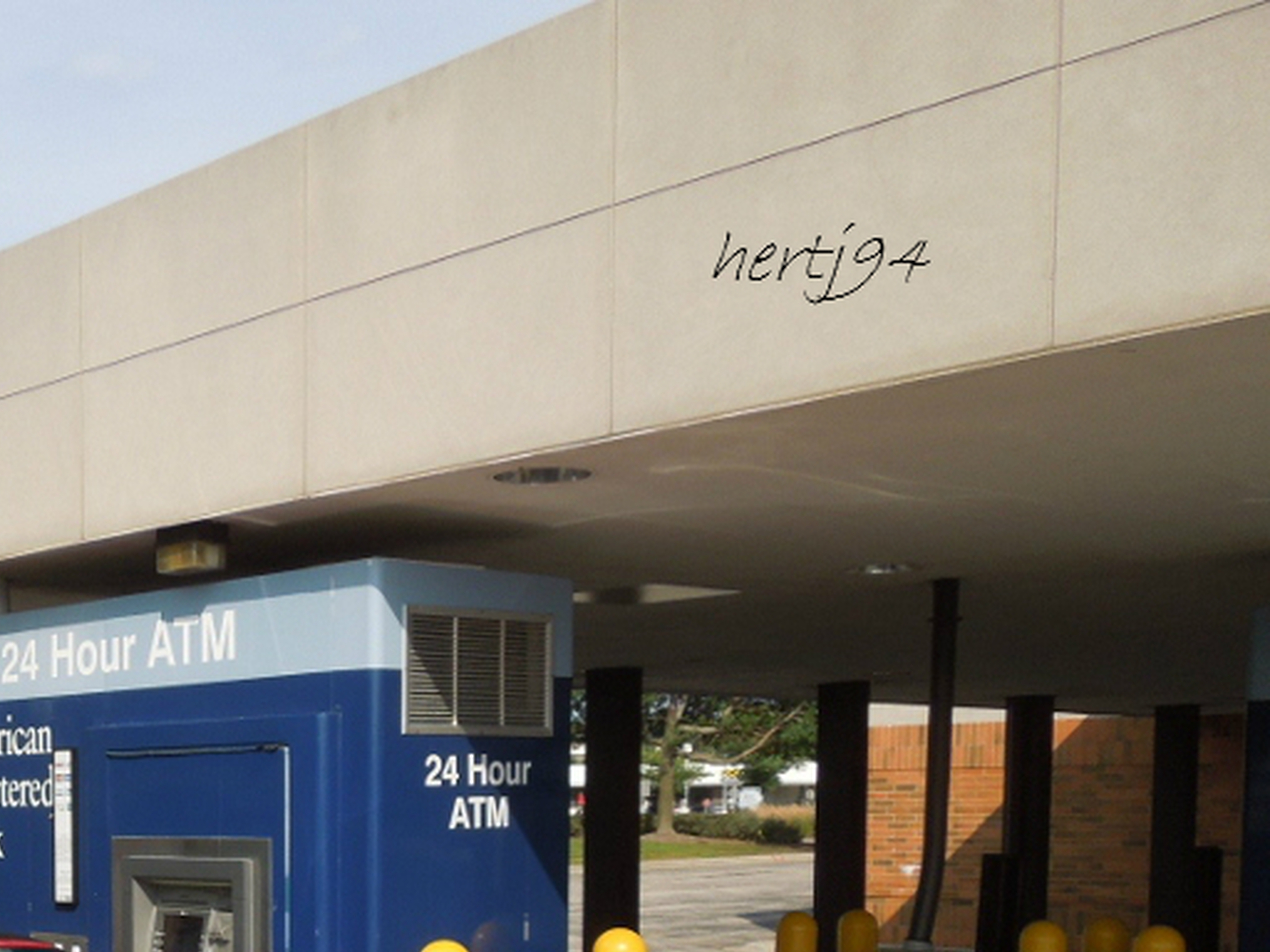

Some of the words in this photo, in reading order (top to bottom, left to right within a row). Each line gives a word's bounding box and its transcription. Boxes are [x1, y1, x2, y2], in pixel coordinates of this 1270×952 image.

[1, 641, 39, 684] 24
[51, 631, 137, 678] Hour
[147, 610, 236, 668] ATM
[425, 753, 459, 786] 24
[467, 753, 531, 786] Hour
[449, 795, 510, 829] ATM
